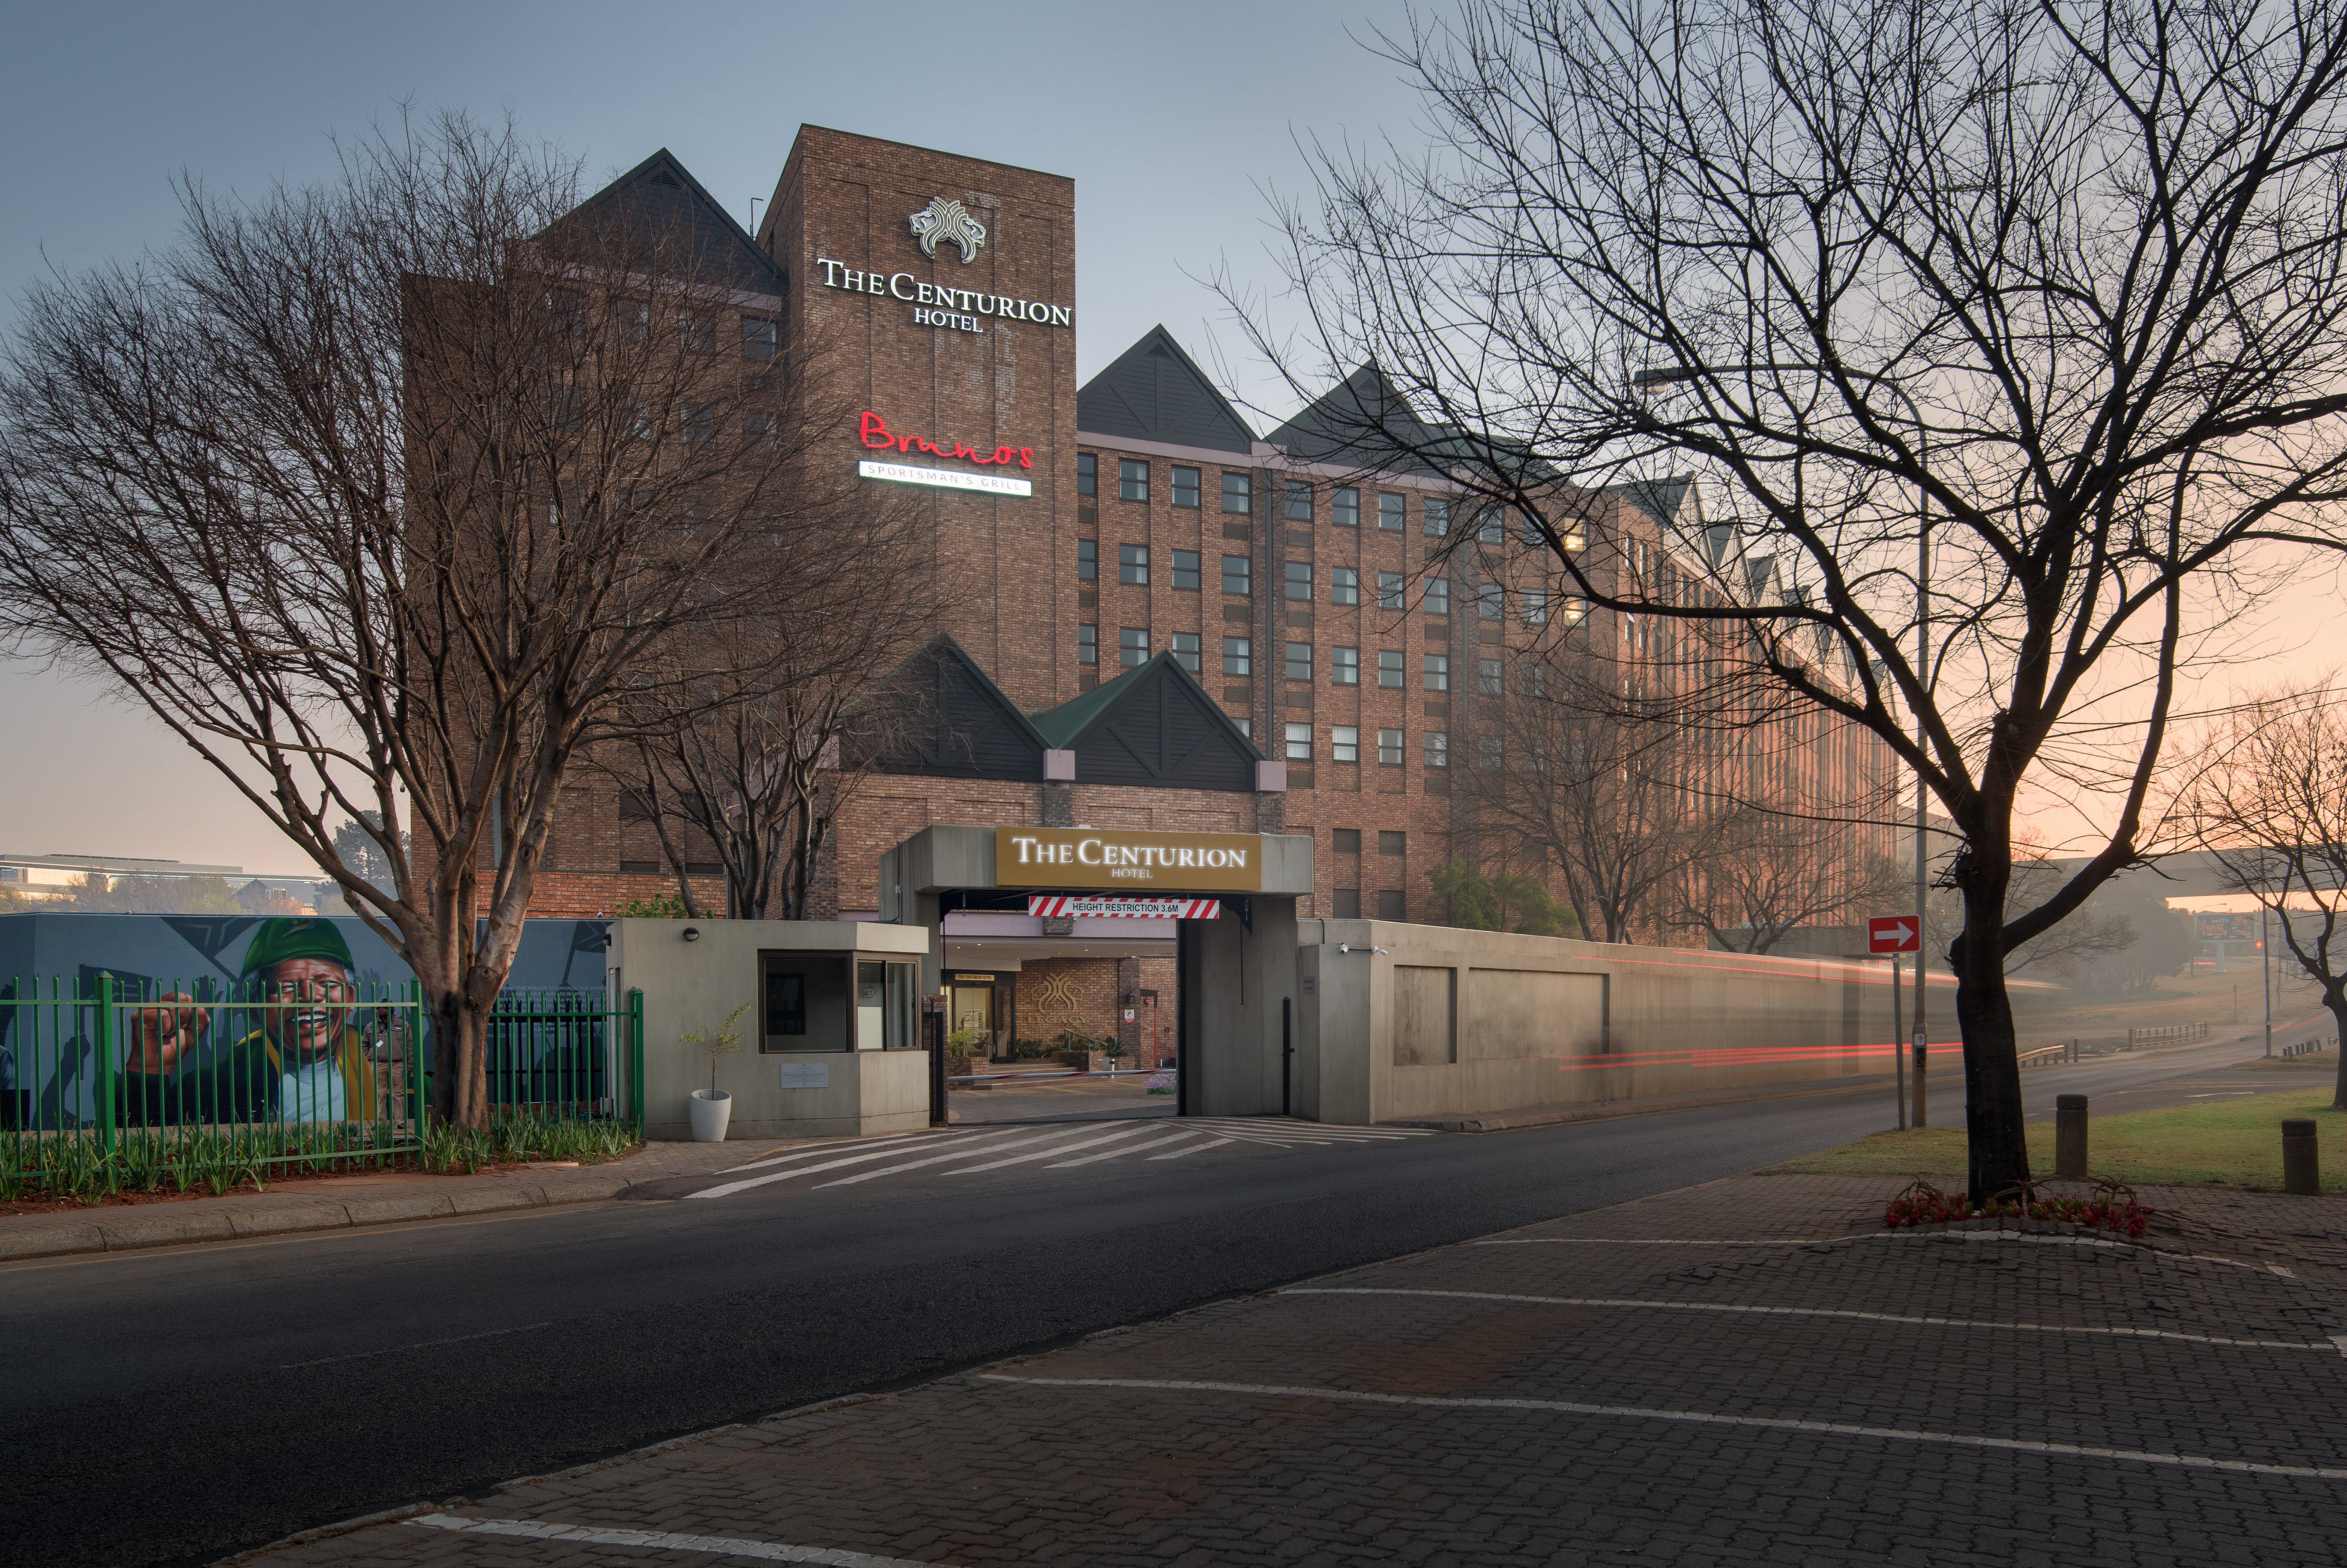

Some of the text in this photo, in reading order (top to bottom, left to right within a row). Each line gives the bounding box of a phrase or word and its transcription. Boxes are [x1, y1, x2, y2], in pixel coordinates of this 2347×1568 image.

[817, 258, 1072, 327] THE CENTURION
[914, 307, 983, 333] HOTEL
[981, 478, 1021, 491] GRILL
[1012, 838, 1247, 868] THE CENTURION
[1111, 868, 1153, 878] HOTEL
[1105, 904, 1159, 912] RESTRICTION
